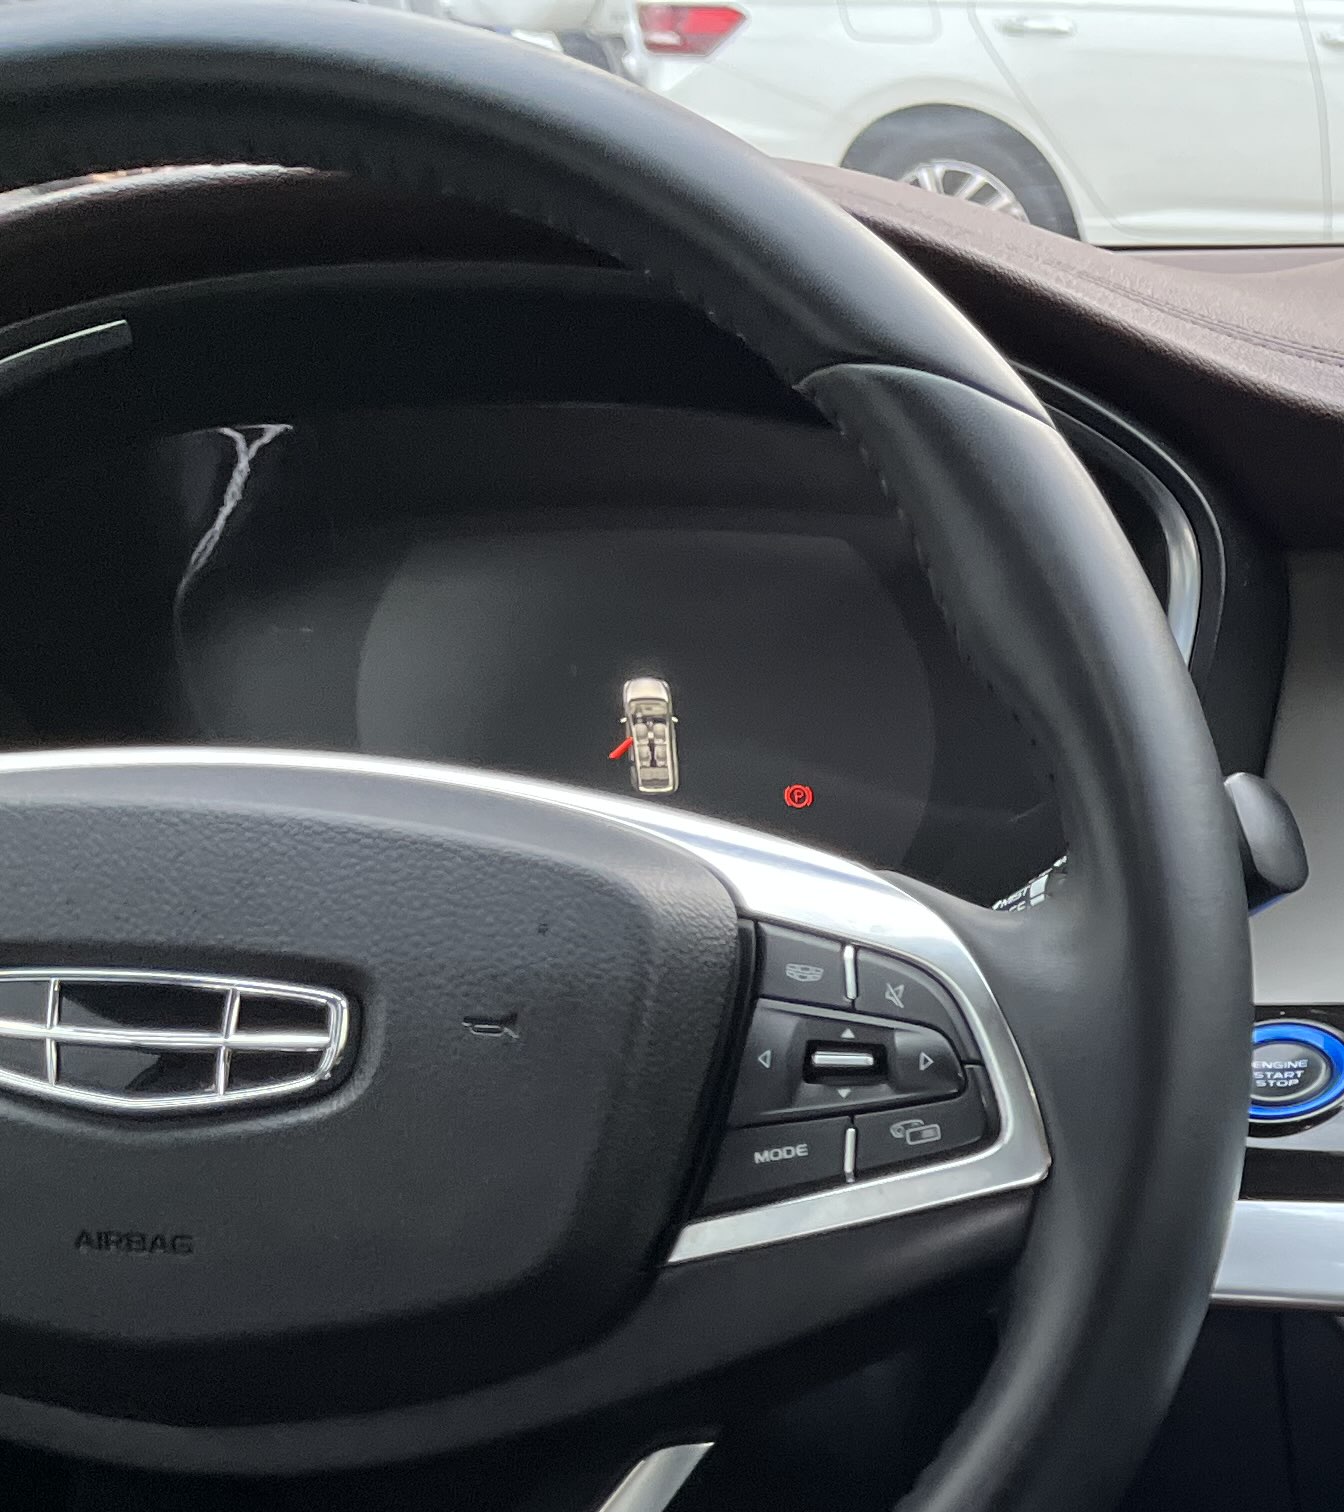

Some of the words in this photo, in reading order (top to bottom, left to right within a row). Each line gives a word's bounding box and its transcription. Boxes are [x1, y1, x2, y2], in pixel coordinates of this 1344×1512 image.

[1252, 1059, 1309, 1070] ENGINE
[1253, 1069, 1305, 1080] START
[1255, 1078, 1300, 1088] STOP
[753, 1143, 809, 1165] MODE
[75, 1230, 194, 1254] AIRBAG
